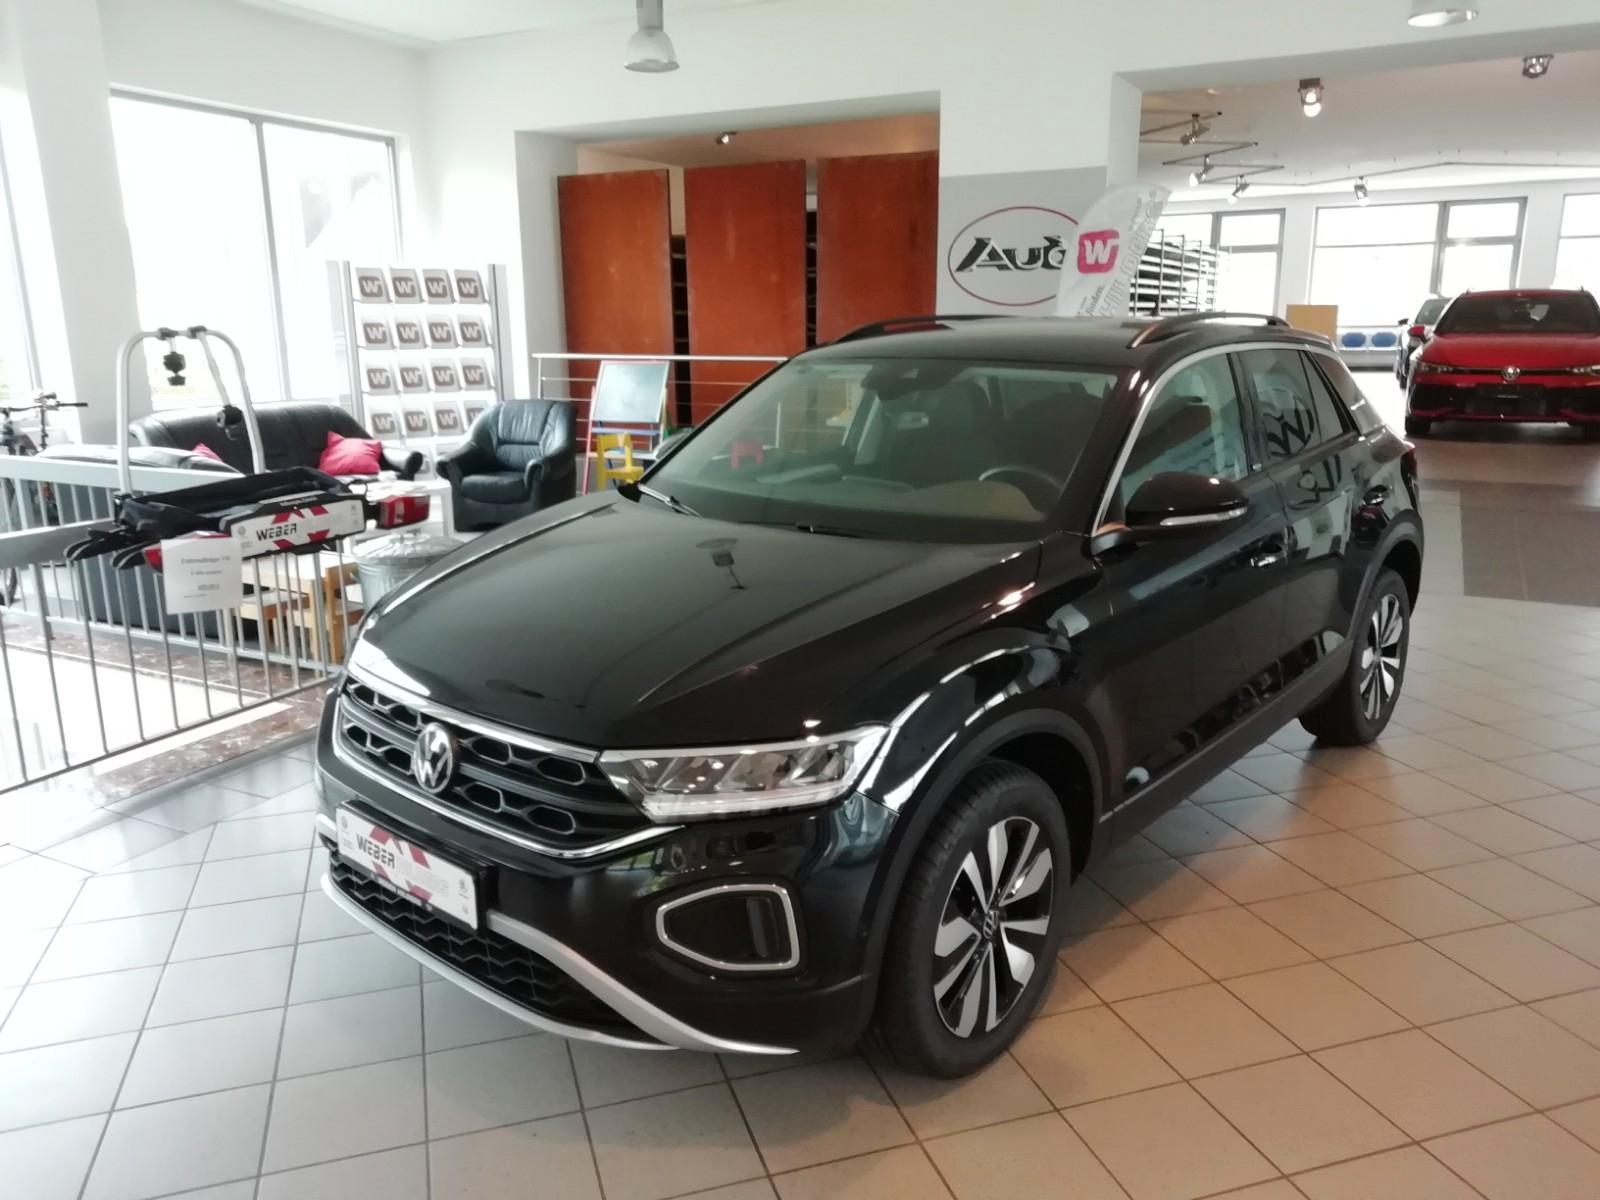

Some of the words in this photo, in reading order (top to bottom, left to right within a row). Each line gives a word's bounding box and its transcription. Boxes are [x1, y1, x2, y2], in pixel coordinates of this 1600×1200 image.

[1081, 237, 1119, 267] W
[361, 278, 382, 295] W
[395, 279, 415, 295] W
[427, 279, 447, 295] W
[459, 280, 478, 295] W
[366, 325, 386, 341] W
[399, 325, 418, 341] W
[431, 324, 450, 340] W
[462, 324, 480, 339] W
[369, 370, 389, 386] W
[402, 369, 422, 385] W
[434, 368, 453, 383] W
[465, 367, 483, 382] W
[374, 415, 394, 431] W
[407, 413, 426, 429] W
[438, 411, 457, 427] W
[255, 523, 297, 541] WEBER
[355, 833, 396, 869] WEBER
